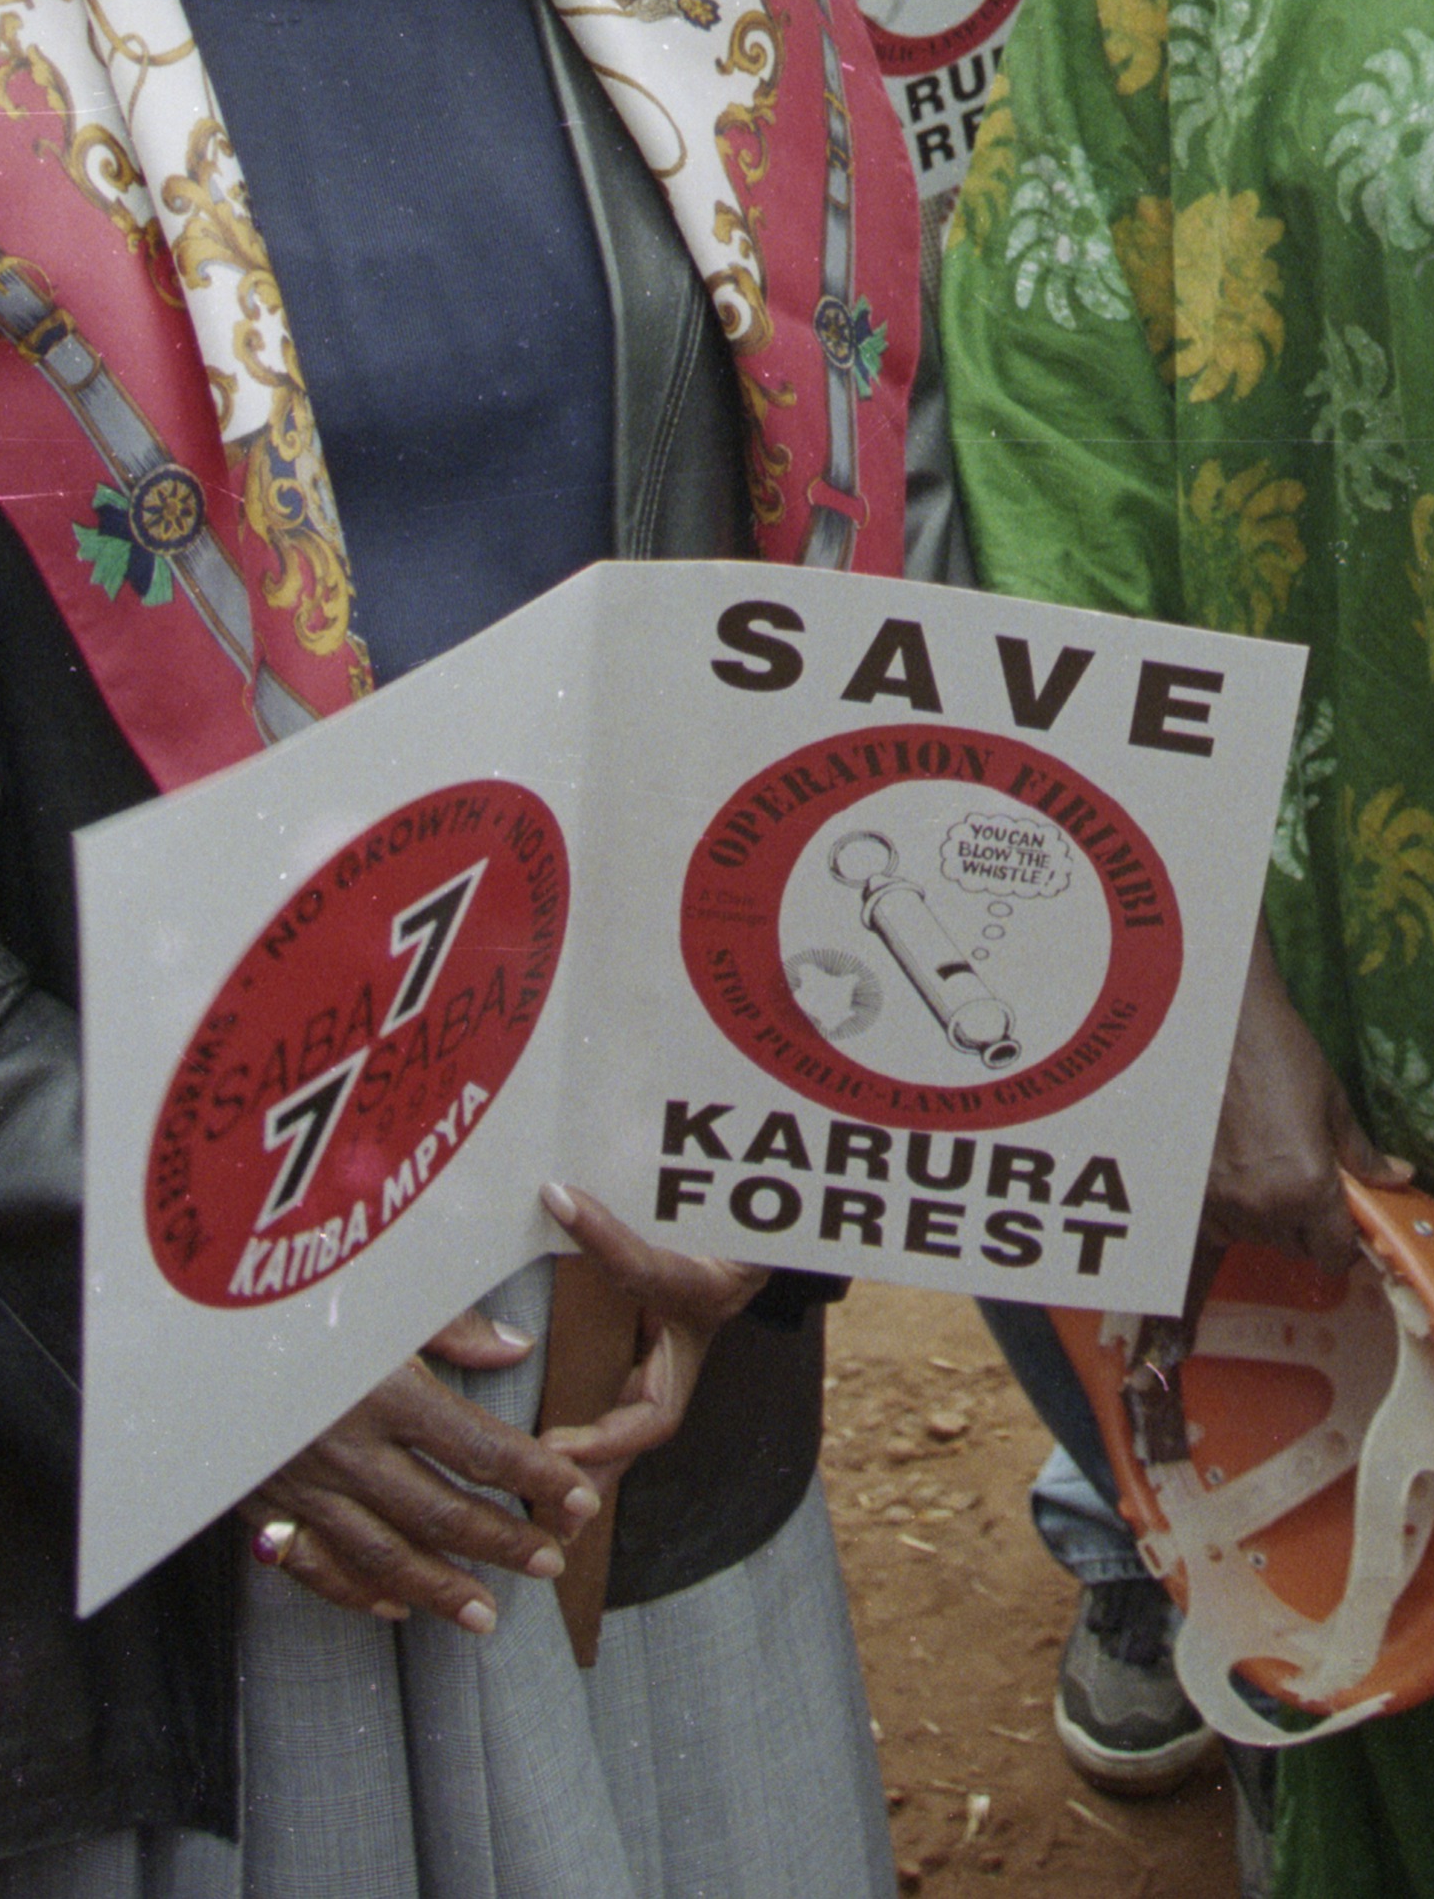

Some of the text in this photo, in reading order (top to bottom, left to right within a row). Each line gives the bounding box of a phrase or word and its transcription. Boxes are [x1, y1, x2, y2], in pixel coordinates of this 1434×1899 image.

[709, 599, 1227, 759] SAVE
[334, 797, 489, 891] GROWTH
[502, 810, 542, 863] NO
[707, 739, 1165, 929] OPERATION FIRIMBI
[957, 841, 1052, 870] BLOW THE
[970, 823, 1046, 849] YOU CAN
[265, 887, 324, 961] NO
[391, 857, 489, 1040] 7
[508, 854, 561, 1033] SURVIVAL
[204, 981, 375, 1143] SABA
[357, 963, 507, 1117] SABA
[706, 947, 762, 1024] STOP
[992, 997, 1139, 1108] GRABBING
[226, 1080, 490, 1297] KATIBA MPYA
[255, 1045, 369, 1234] 7
[660, 1098, 1133, 1215] KARURA
[654, 1165, 1130, 1279] FOREST
